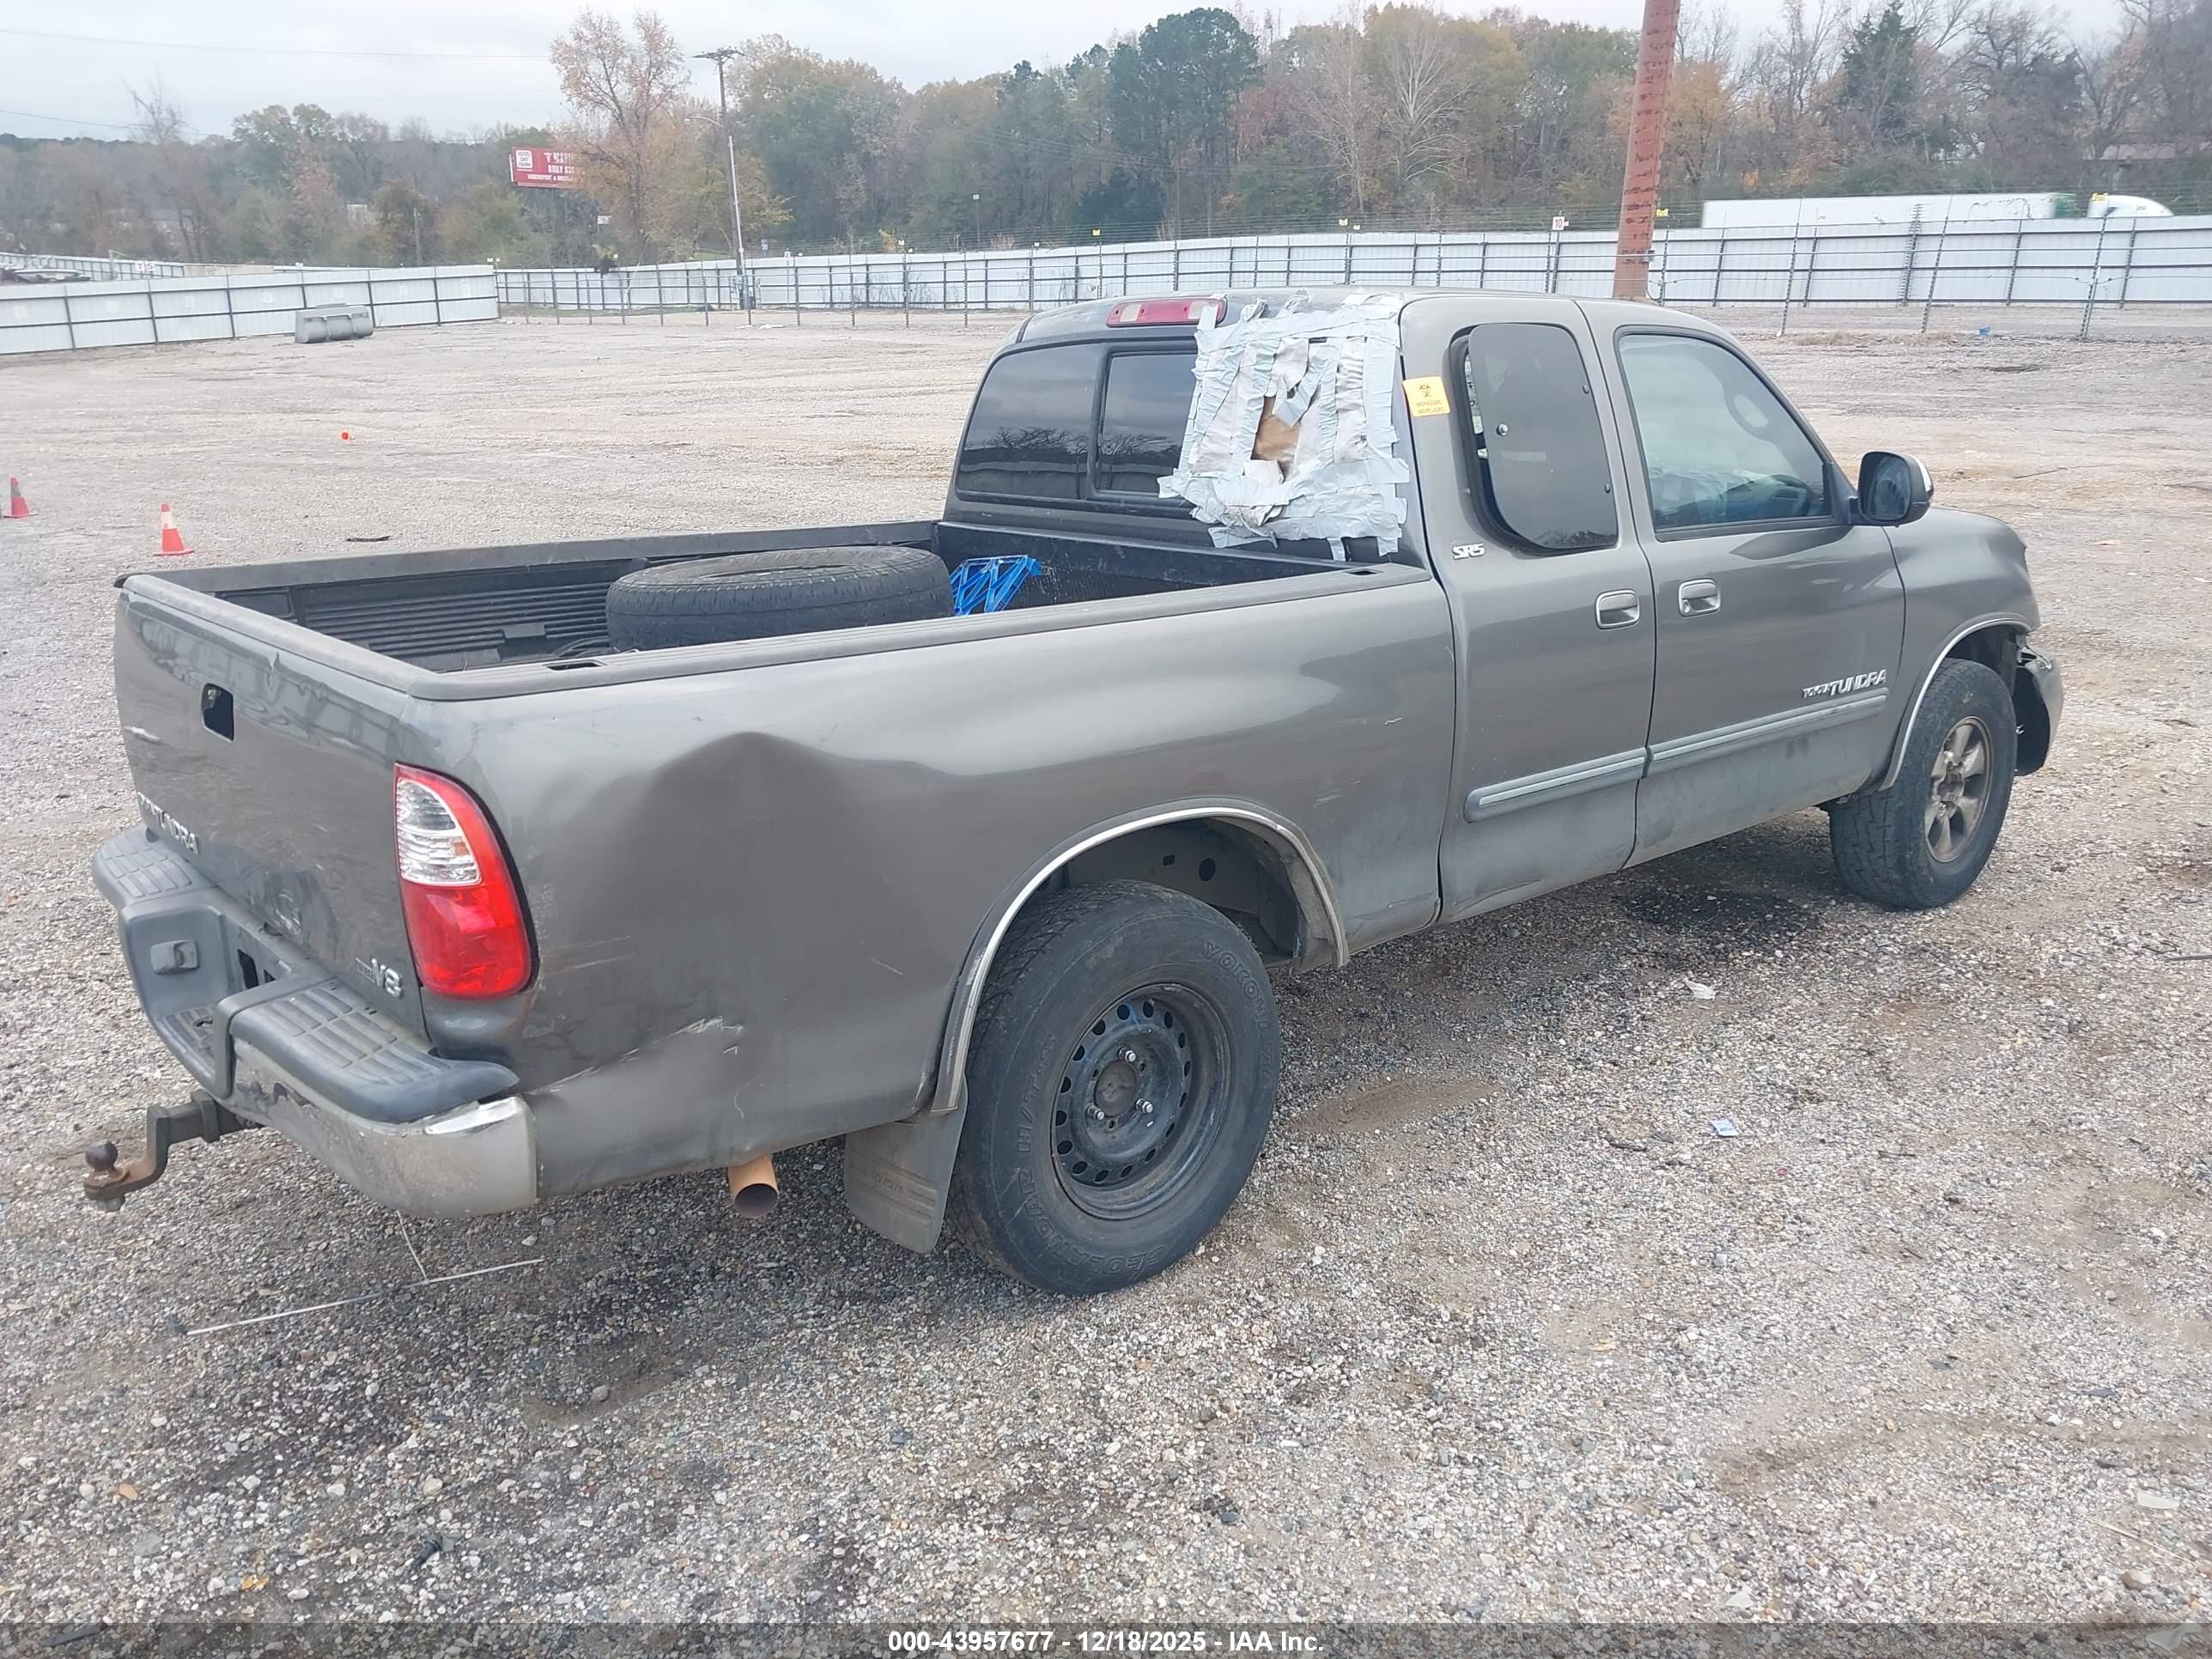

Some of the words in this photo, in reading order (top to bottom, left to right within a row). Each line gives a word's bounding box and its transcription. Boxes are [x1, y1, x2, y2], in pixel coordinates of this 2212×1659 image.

[1554, 218, 1563, 228] 10
[1452, 543, 1486, 560] SR5
[1828, 669, 1887, 696] TUNDRA
[370, 957, 403, 997] V8
